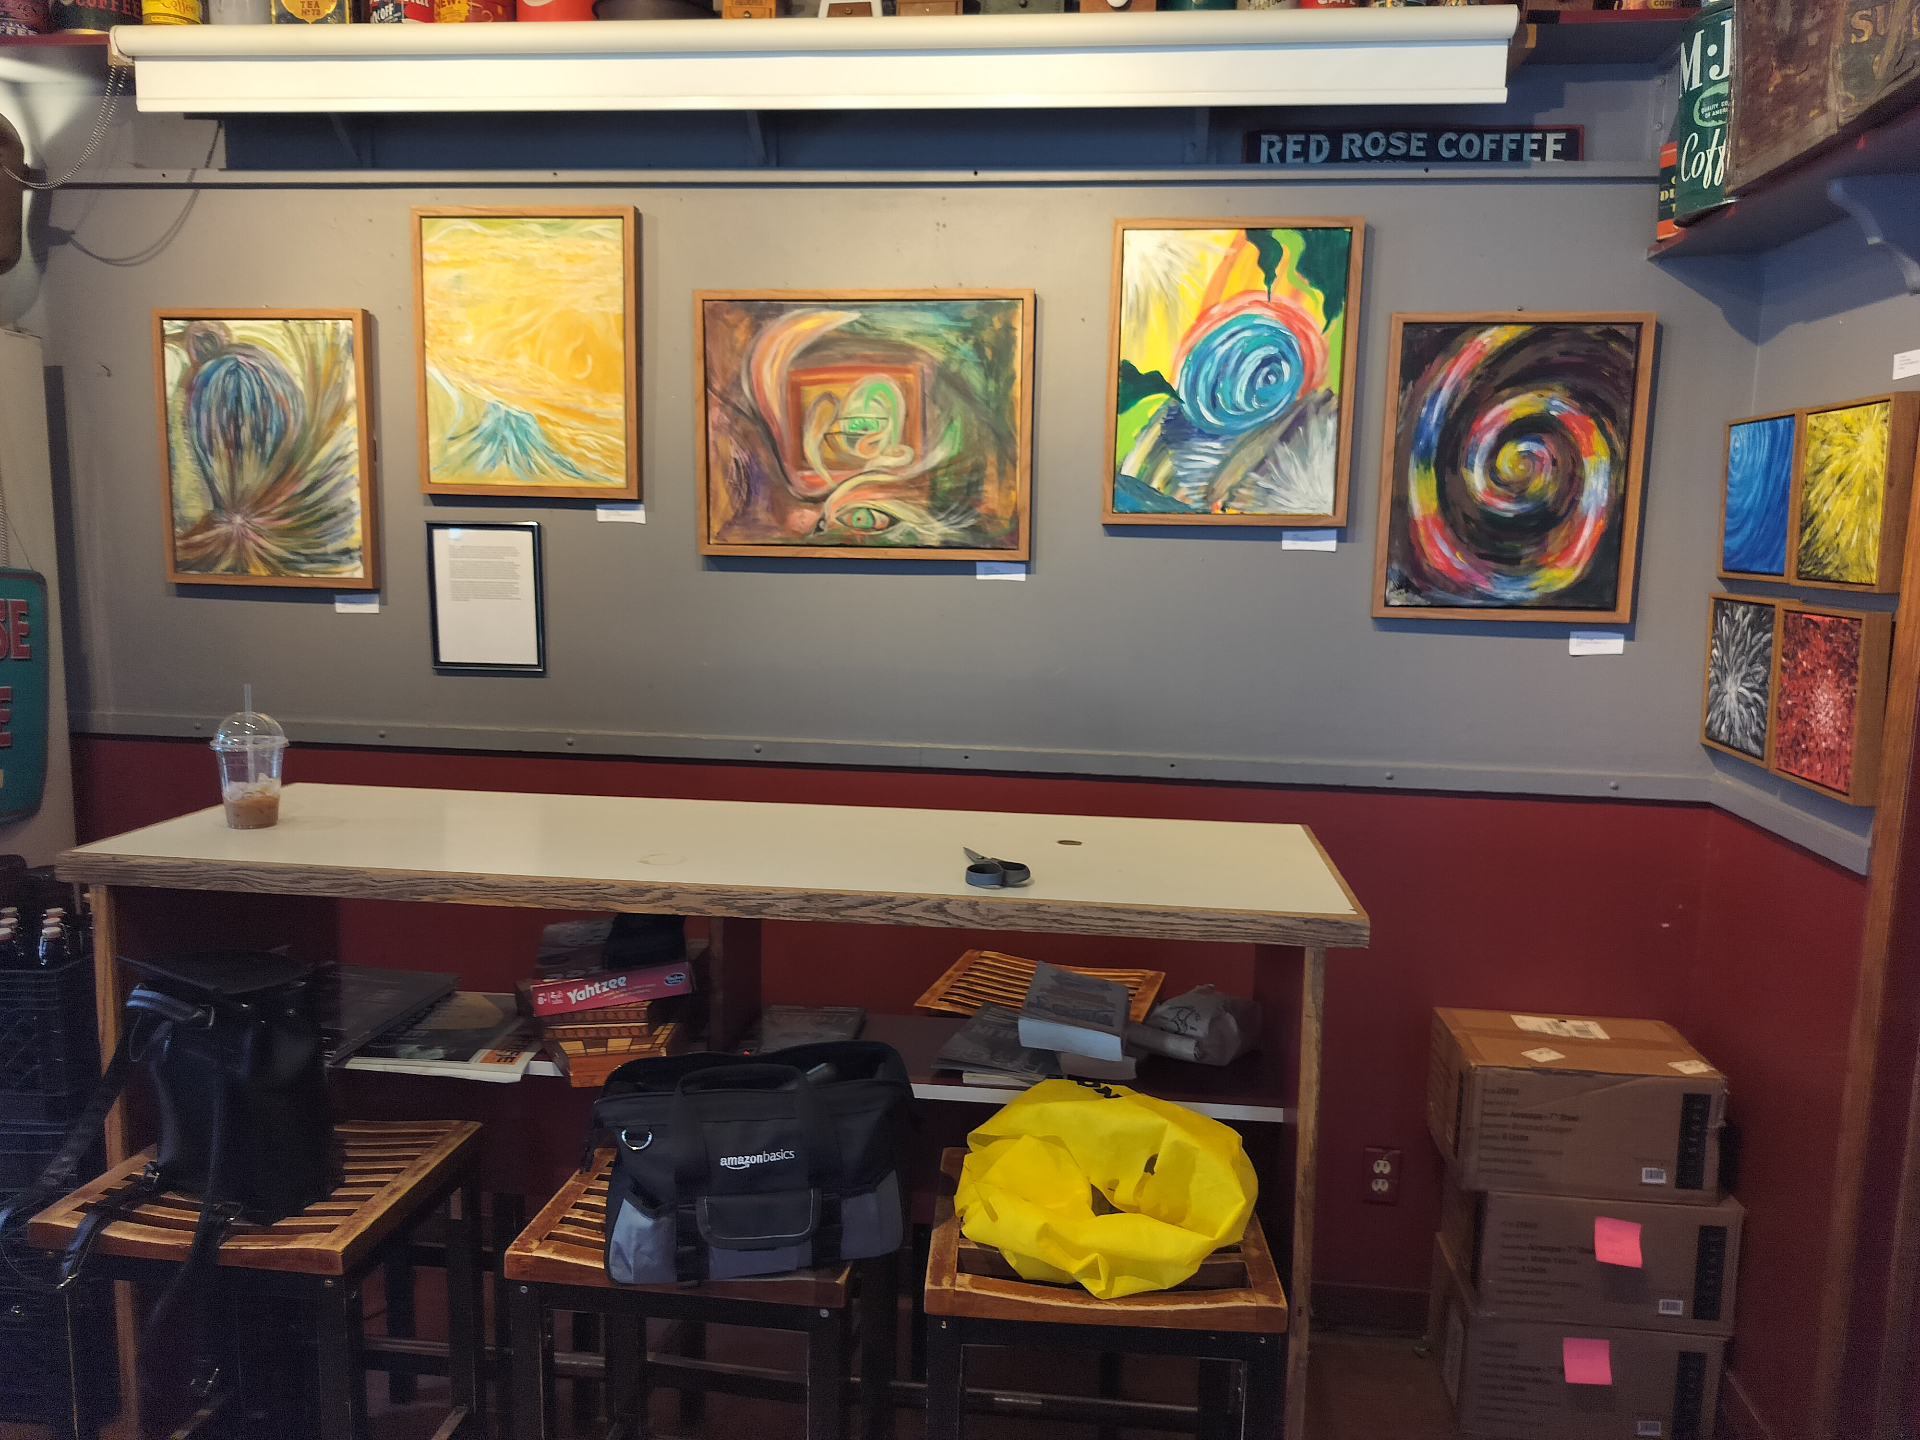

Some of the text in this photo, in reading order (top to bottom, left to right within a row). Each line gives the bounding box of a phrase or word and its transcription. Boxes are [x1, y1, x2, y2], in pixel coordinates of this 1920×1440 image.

[1259, 131, 1566, 164] RED ROSE COFFEE
[566, 976, 627, 1005] Yahtzee
[720, 1149, 795, 1169] amazonbasics
